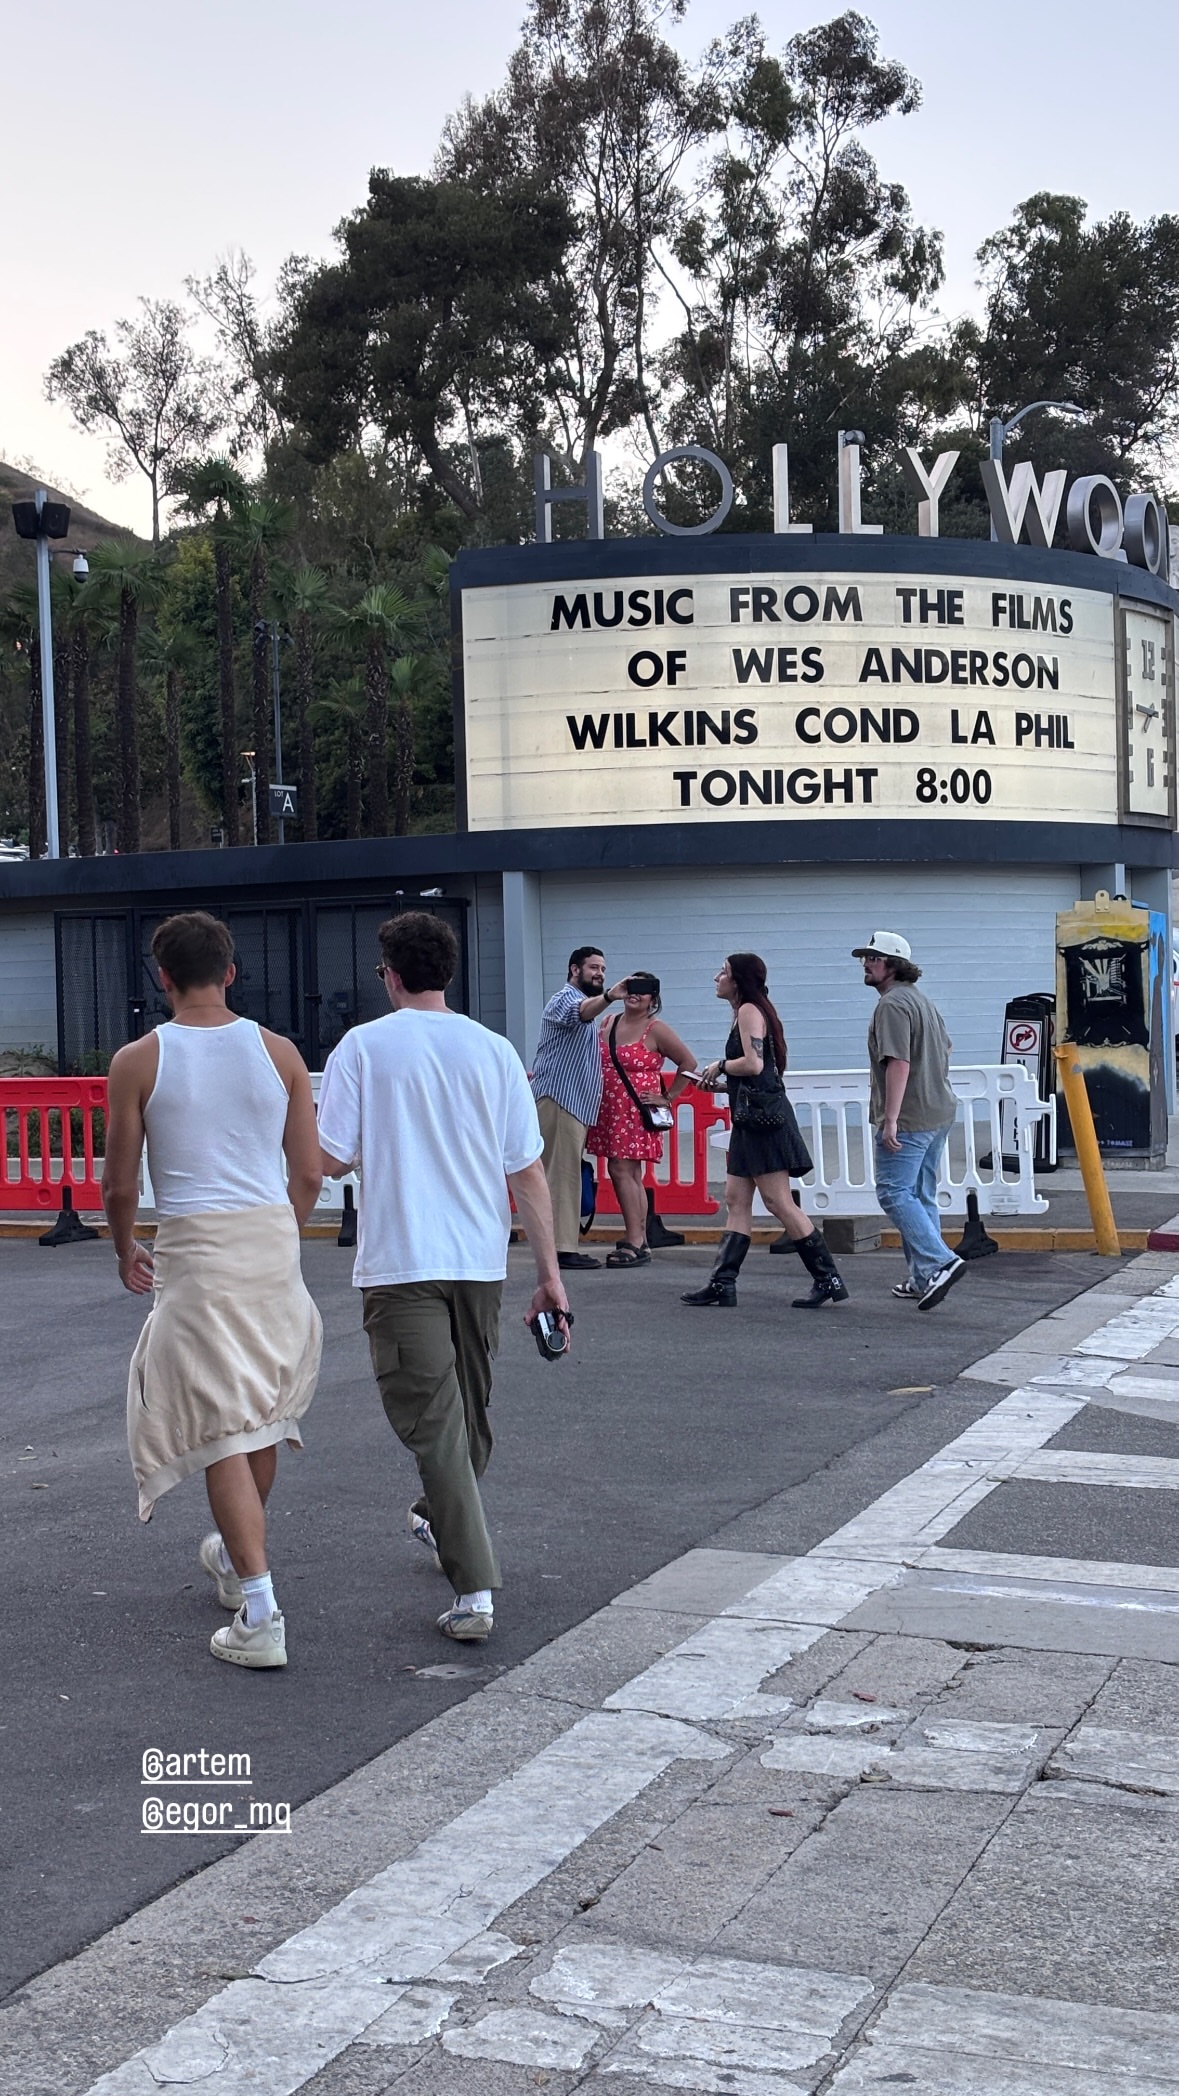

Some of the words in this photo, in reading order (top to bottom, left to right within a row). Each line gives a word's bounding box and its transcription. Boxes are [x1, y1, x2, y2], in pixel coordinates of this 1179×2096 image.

[551, 589, 694, 631] MUSIC
[731, 586, 863, 623] FROM
[896, 587, 964, 625] THE
[992, 592, 1074, 635] FILMS
[628, 649, 687, 688] OF
[733, 646, 825, 684] WES
[859, 647, 1059, 690] ANDERSON
[566, 709, 758, 750] WILKINS
[796, 707, 920, 746] COND
[952, 709, 996, 746] LA
[1016, 712, 1075, 749] PHIL
[282, 792, 295, 813] A
[673, 768, 879, 807] TONIGHT
[916, 767, 992, 805] 8:00
